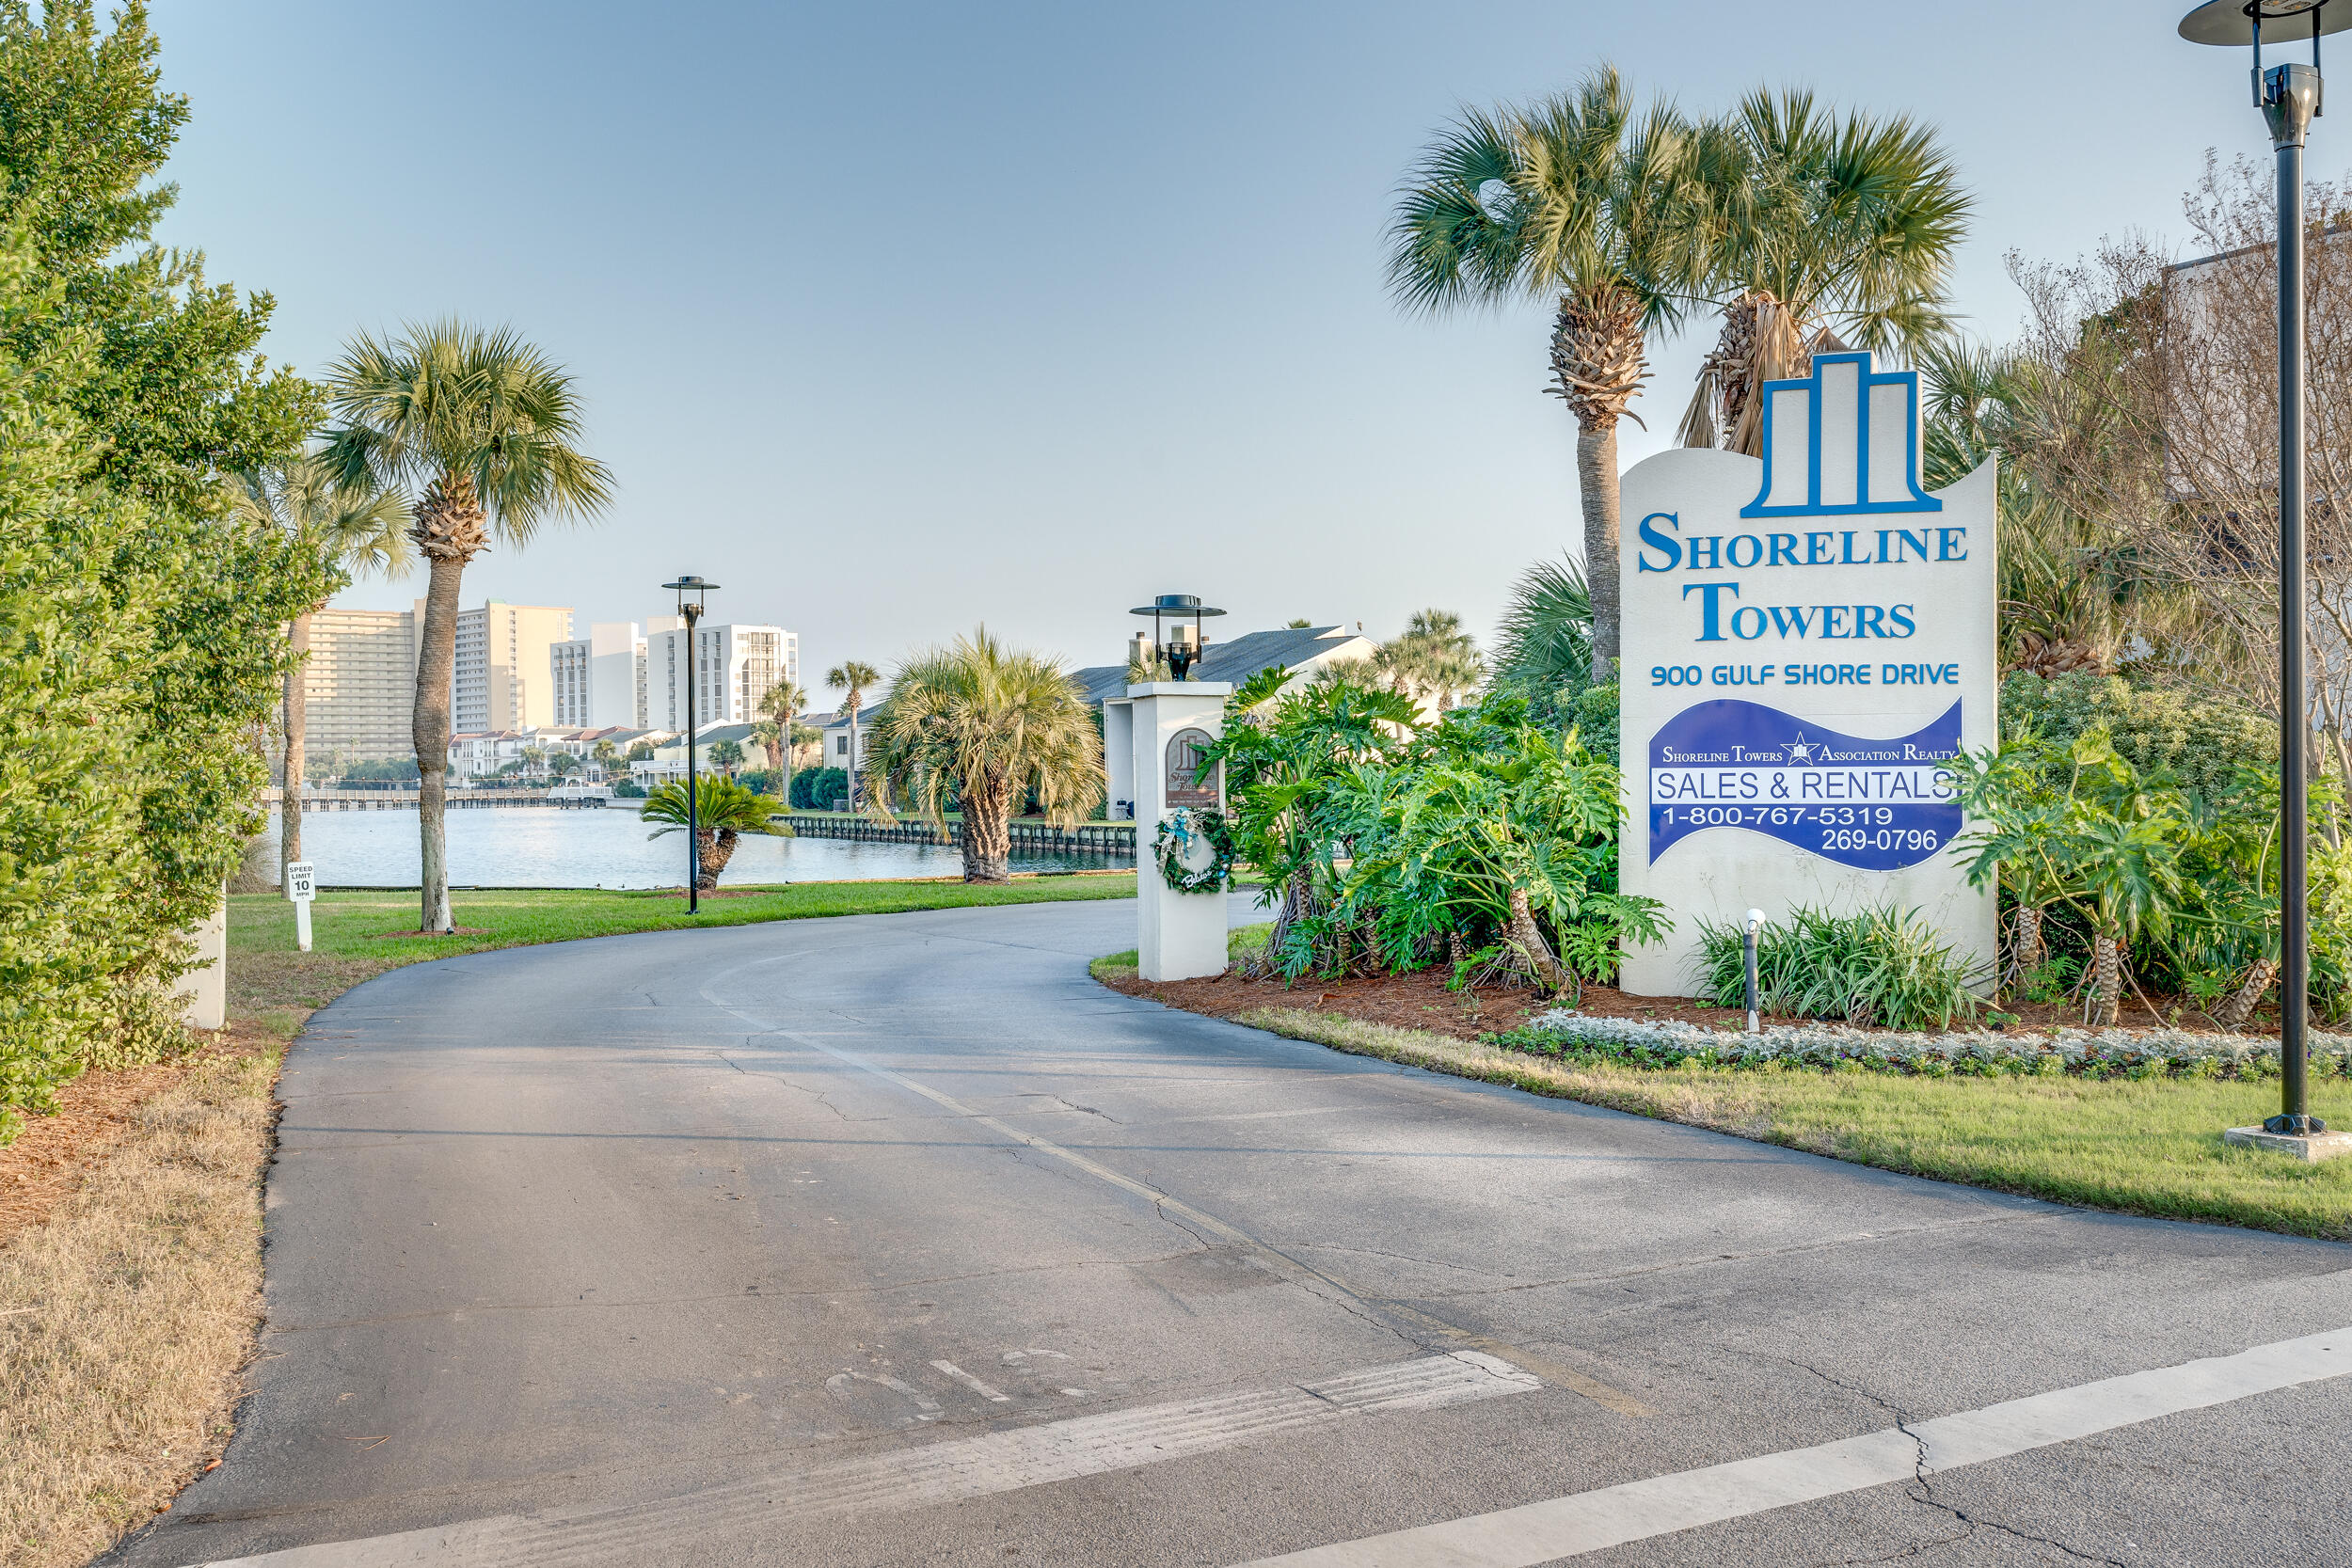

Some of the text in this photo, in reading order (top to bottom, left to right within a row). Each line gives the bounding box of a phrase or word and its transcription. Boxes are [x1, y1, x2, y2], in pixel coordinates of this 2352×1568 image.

[1639, 511, 1968, 573] SHORELINE
[1683, 581, 1916, 641] TOWERS
[1651, 663, 1959, 687] 900 GULF SHORE DRIVE
[1662, 743, 1956, 763] SHORELINE TOWERS ASSOCIATION REALTY
[1657, 770, 1953, 799] SALES & RENTALS
[1662, 807, 1894, 826] 1-800-767-5319
[1821, 829, 1938, 850] 269-0796
[294, 880, 309, 890] 10
